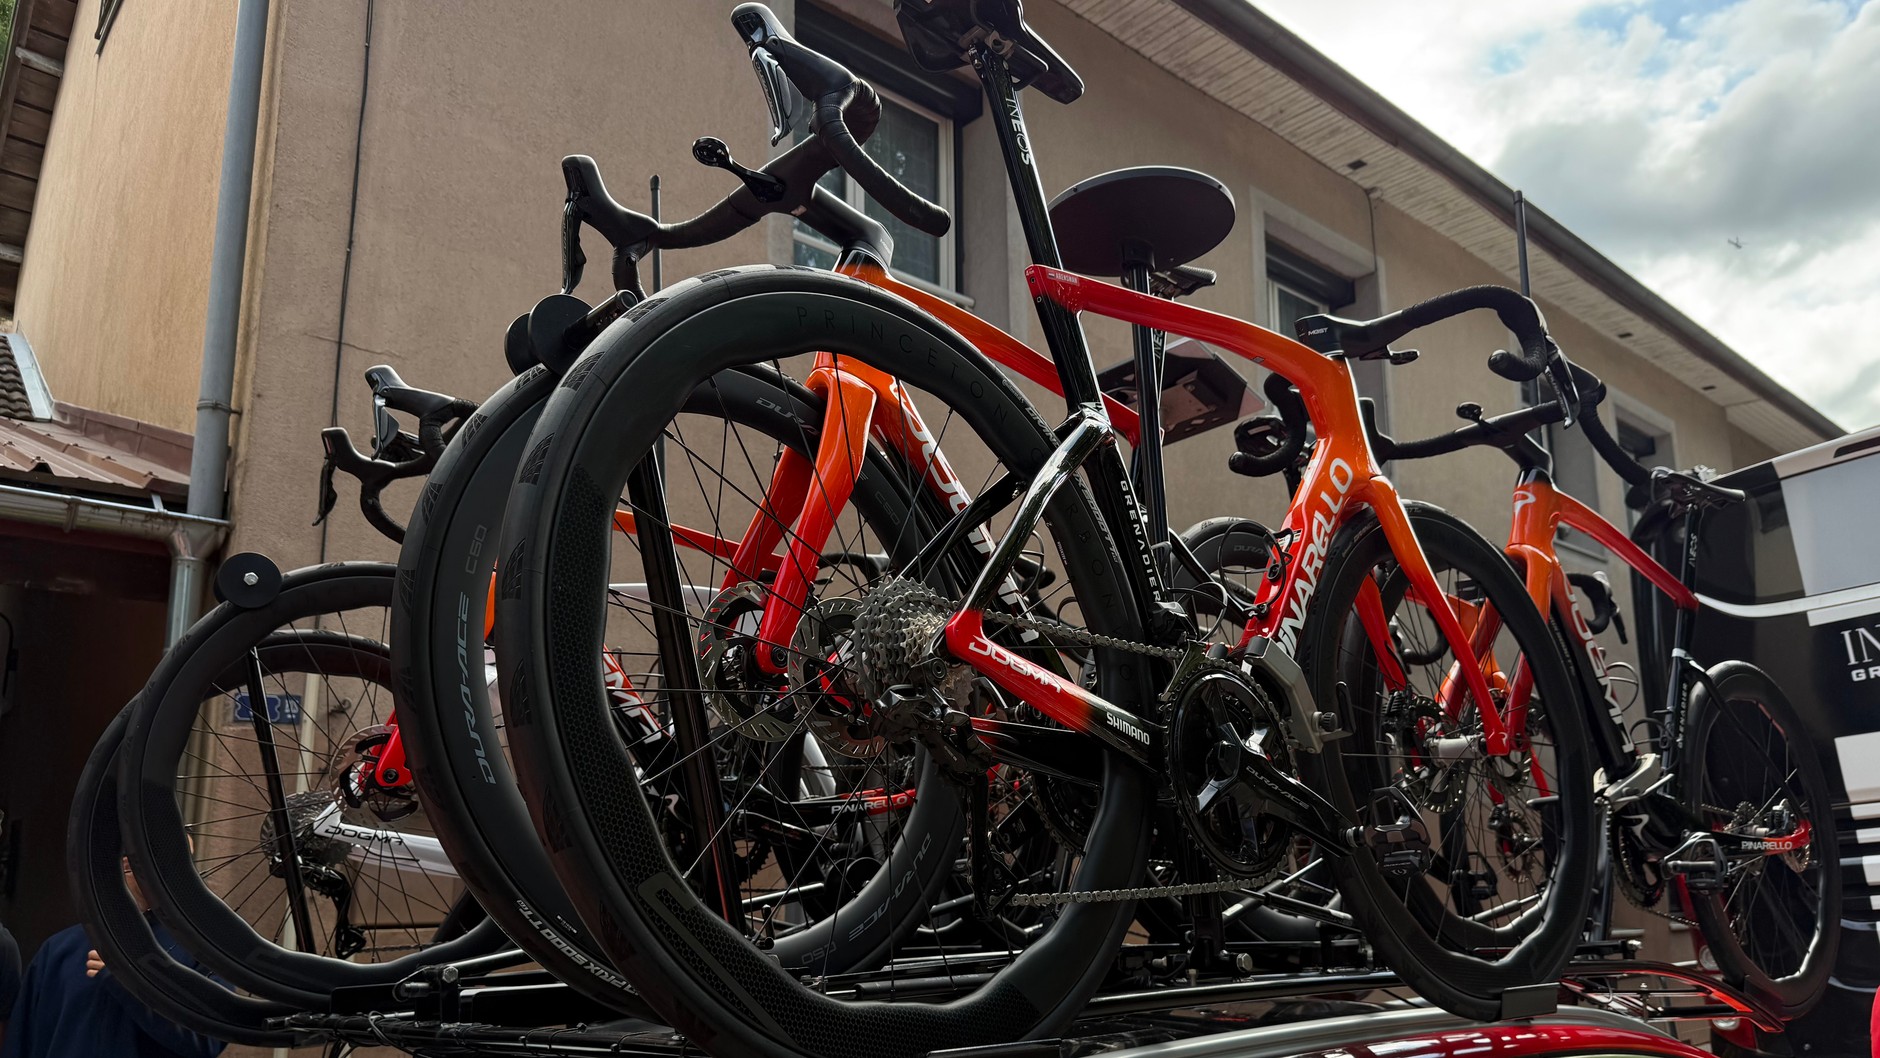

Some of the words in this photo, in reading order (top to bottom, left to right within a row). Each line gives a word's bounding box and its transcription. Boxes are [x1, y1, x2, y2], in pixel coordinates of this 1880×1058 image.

[1005, 97, 1032, 165] INEOS
[1308, 327, 1328, 336] MOST
[796, 306, 1008, 424] PRINCETON
[1120, 480, 1161, 602] GRENADIER
[968, 636, 1062, 694] DOGMA
[457, 592, 497, 785] DURA-ACE
[1106, 711, 1151, 746] SHIMANO
[831, 796, 908, 815] PINARELLO
[1245, 765, 1310, 810] DURA-ACE
[325, 825, 403, 846] DOGMA
[1741, 840, 1793, 850] PINARELLO
[848, 832, 932, 942] DURA-ACE
[540, 928, 588, 966] 5000
